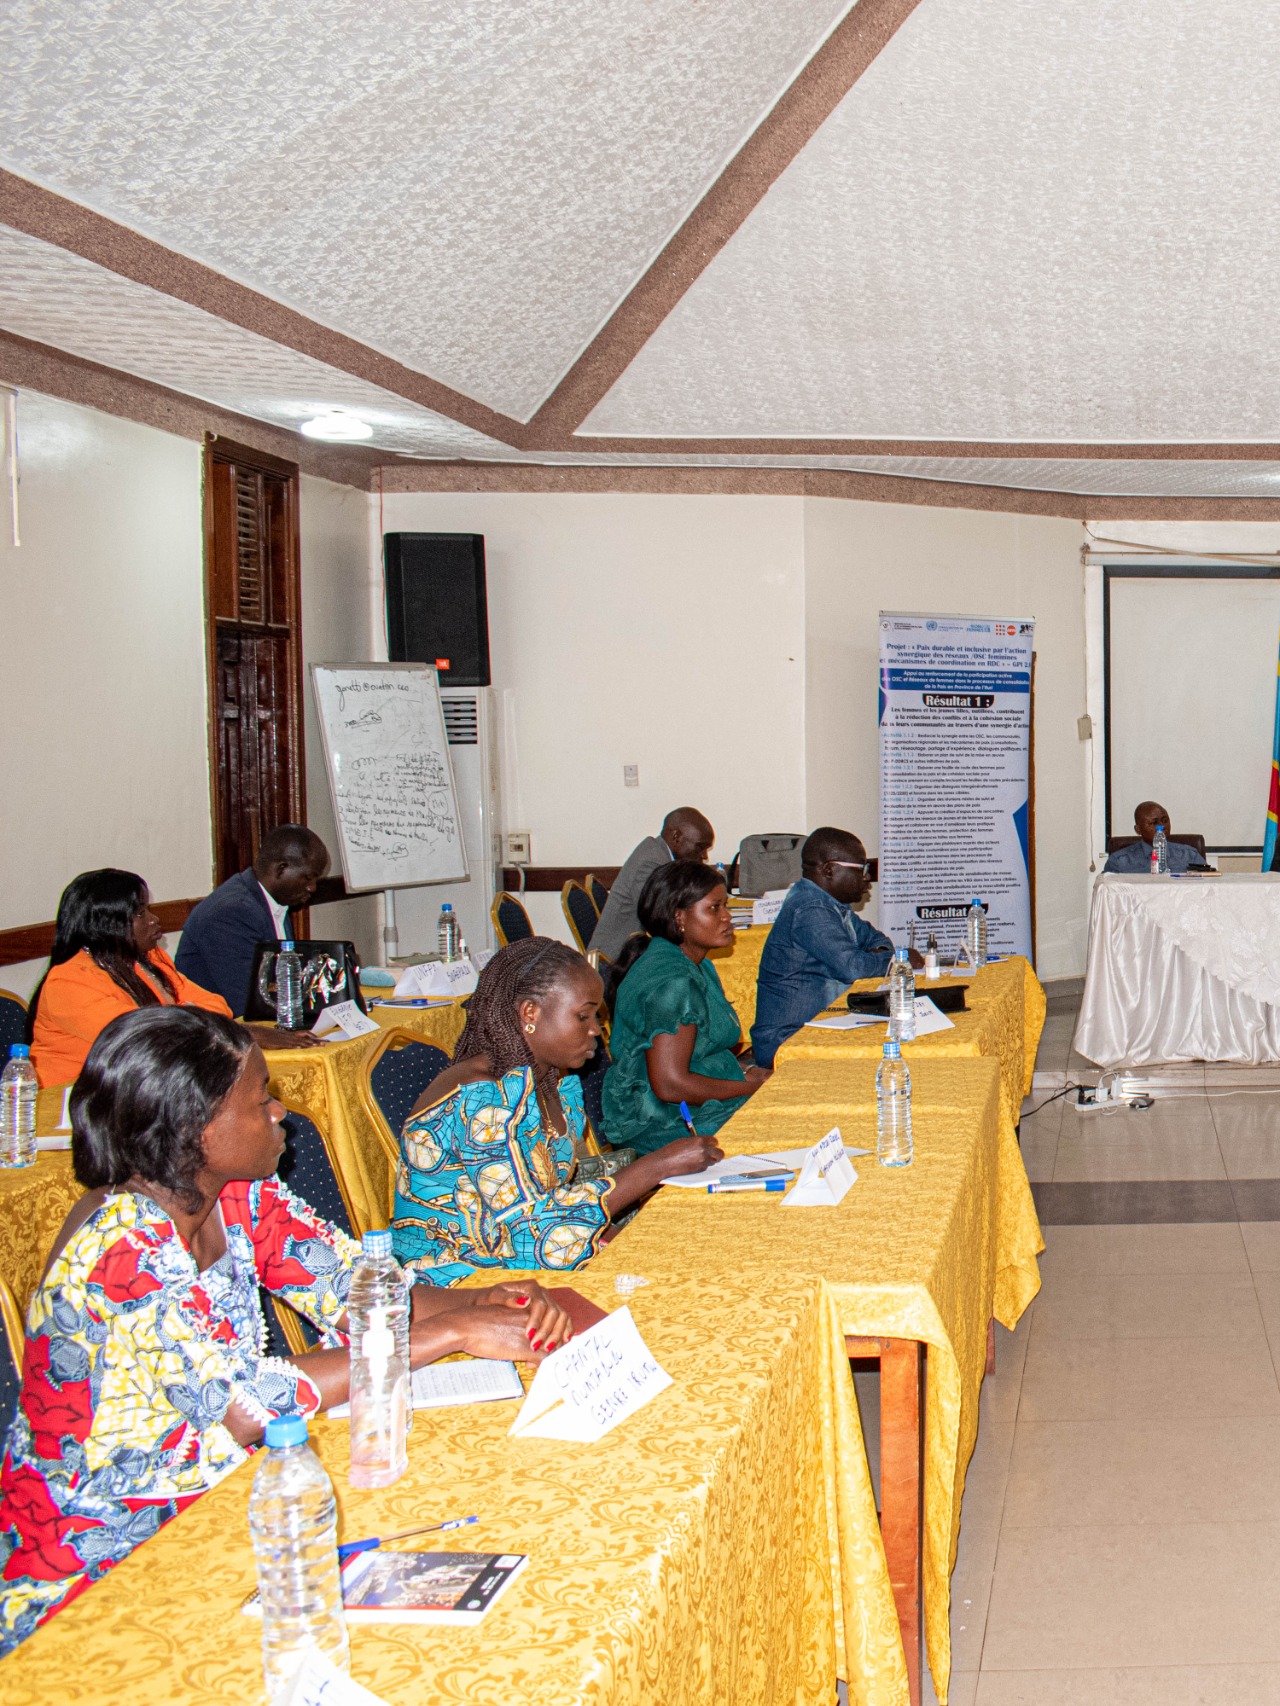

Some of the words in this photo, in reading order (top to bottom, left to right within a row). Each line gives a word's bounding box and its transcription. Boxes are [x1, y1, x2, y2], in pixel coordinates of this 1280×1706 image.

[926, 696, 971, 707] Résultat
[921, 907, 967, 918] Résultat
[554, 1335, 612, 1388] CHANTAL
